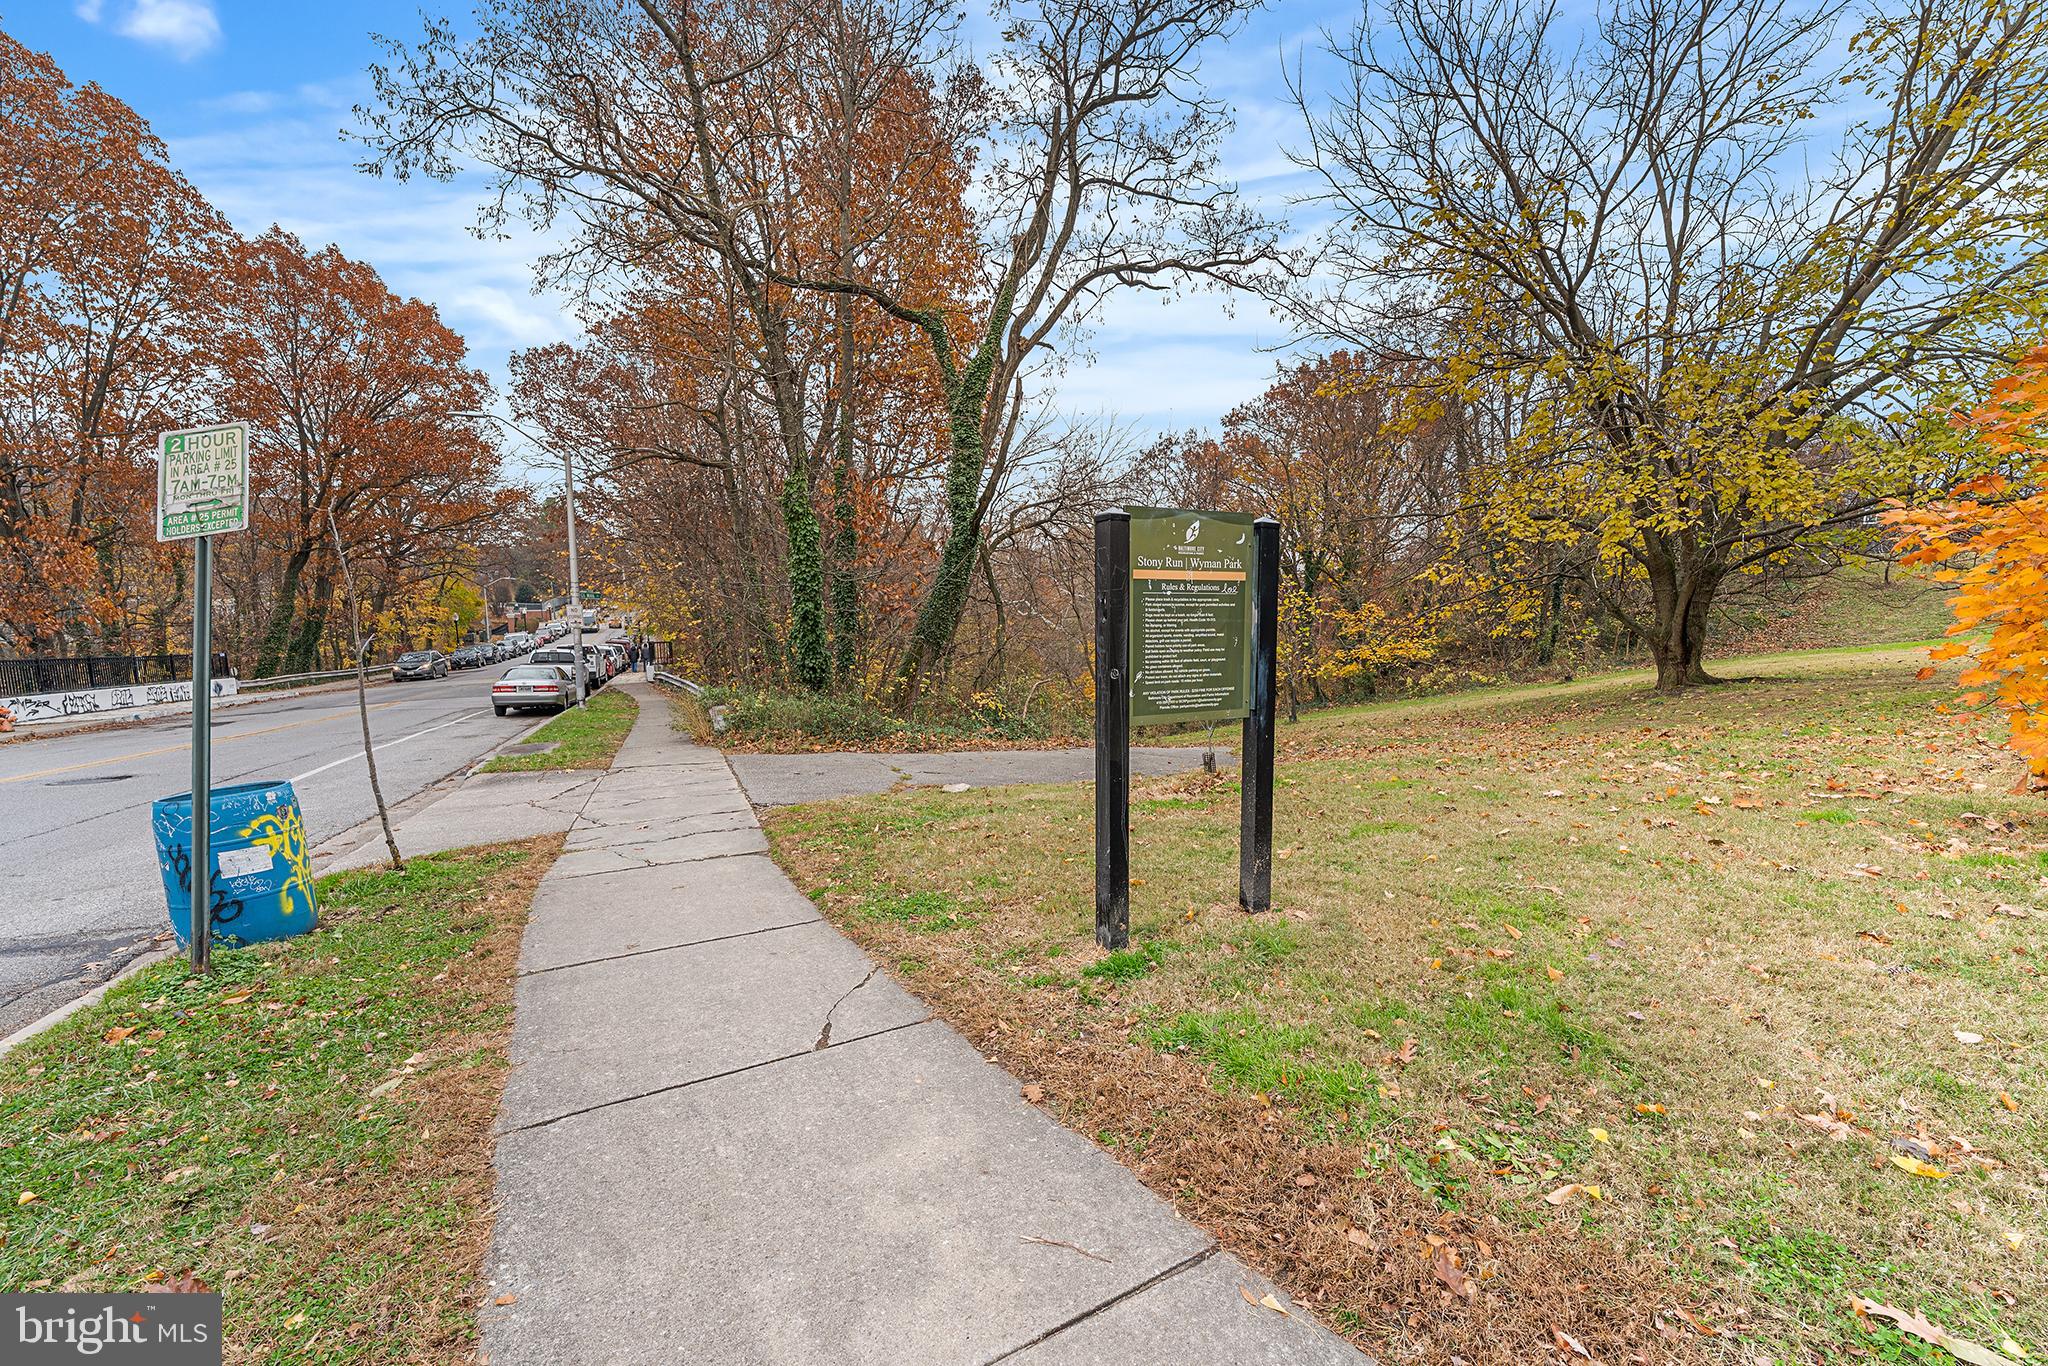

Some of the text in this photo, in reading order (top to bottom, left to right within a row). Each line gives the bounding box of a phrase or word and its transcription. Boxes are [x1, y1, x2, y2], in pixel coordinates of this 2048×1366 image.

[171, 432, 236, 452] 2 HOUR
[170, 446, 238, 466] PARKING LIMIT
[170, 460, 237, 478] IN AREA # 25
[171, 474, 238, 494] 7AM-7PM
[194, 490, 218, 499] THRU
[220, 488, 235, 496] FRI
[168, 508, 238, 526] AREA # 25 PERMIT
[166, 524, 200, 536] HOLDERS
[1138, 556, 1164, 570] Stony
[1166, 557, 1183, 568] Run
[1190, 558, 1222, 570] Wyman
[1224, 558, 1242, 569] Park
[1162, 583, 1178, 591] Rules
[1186, 584, 1220, 593] Regulations
